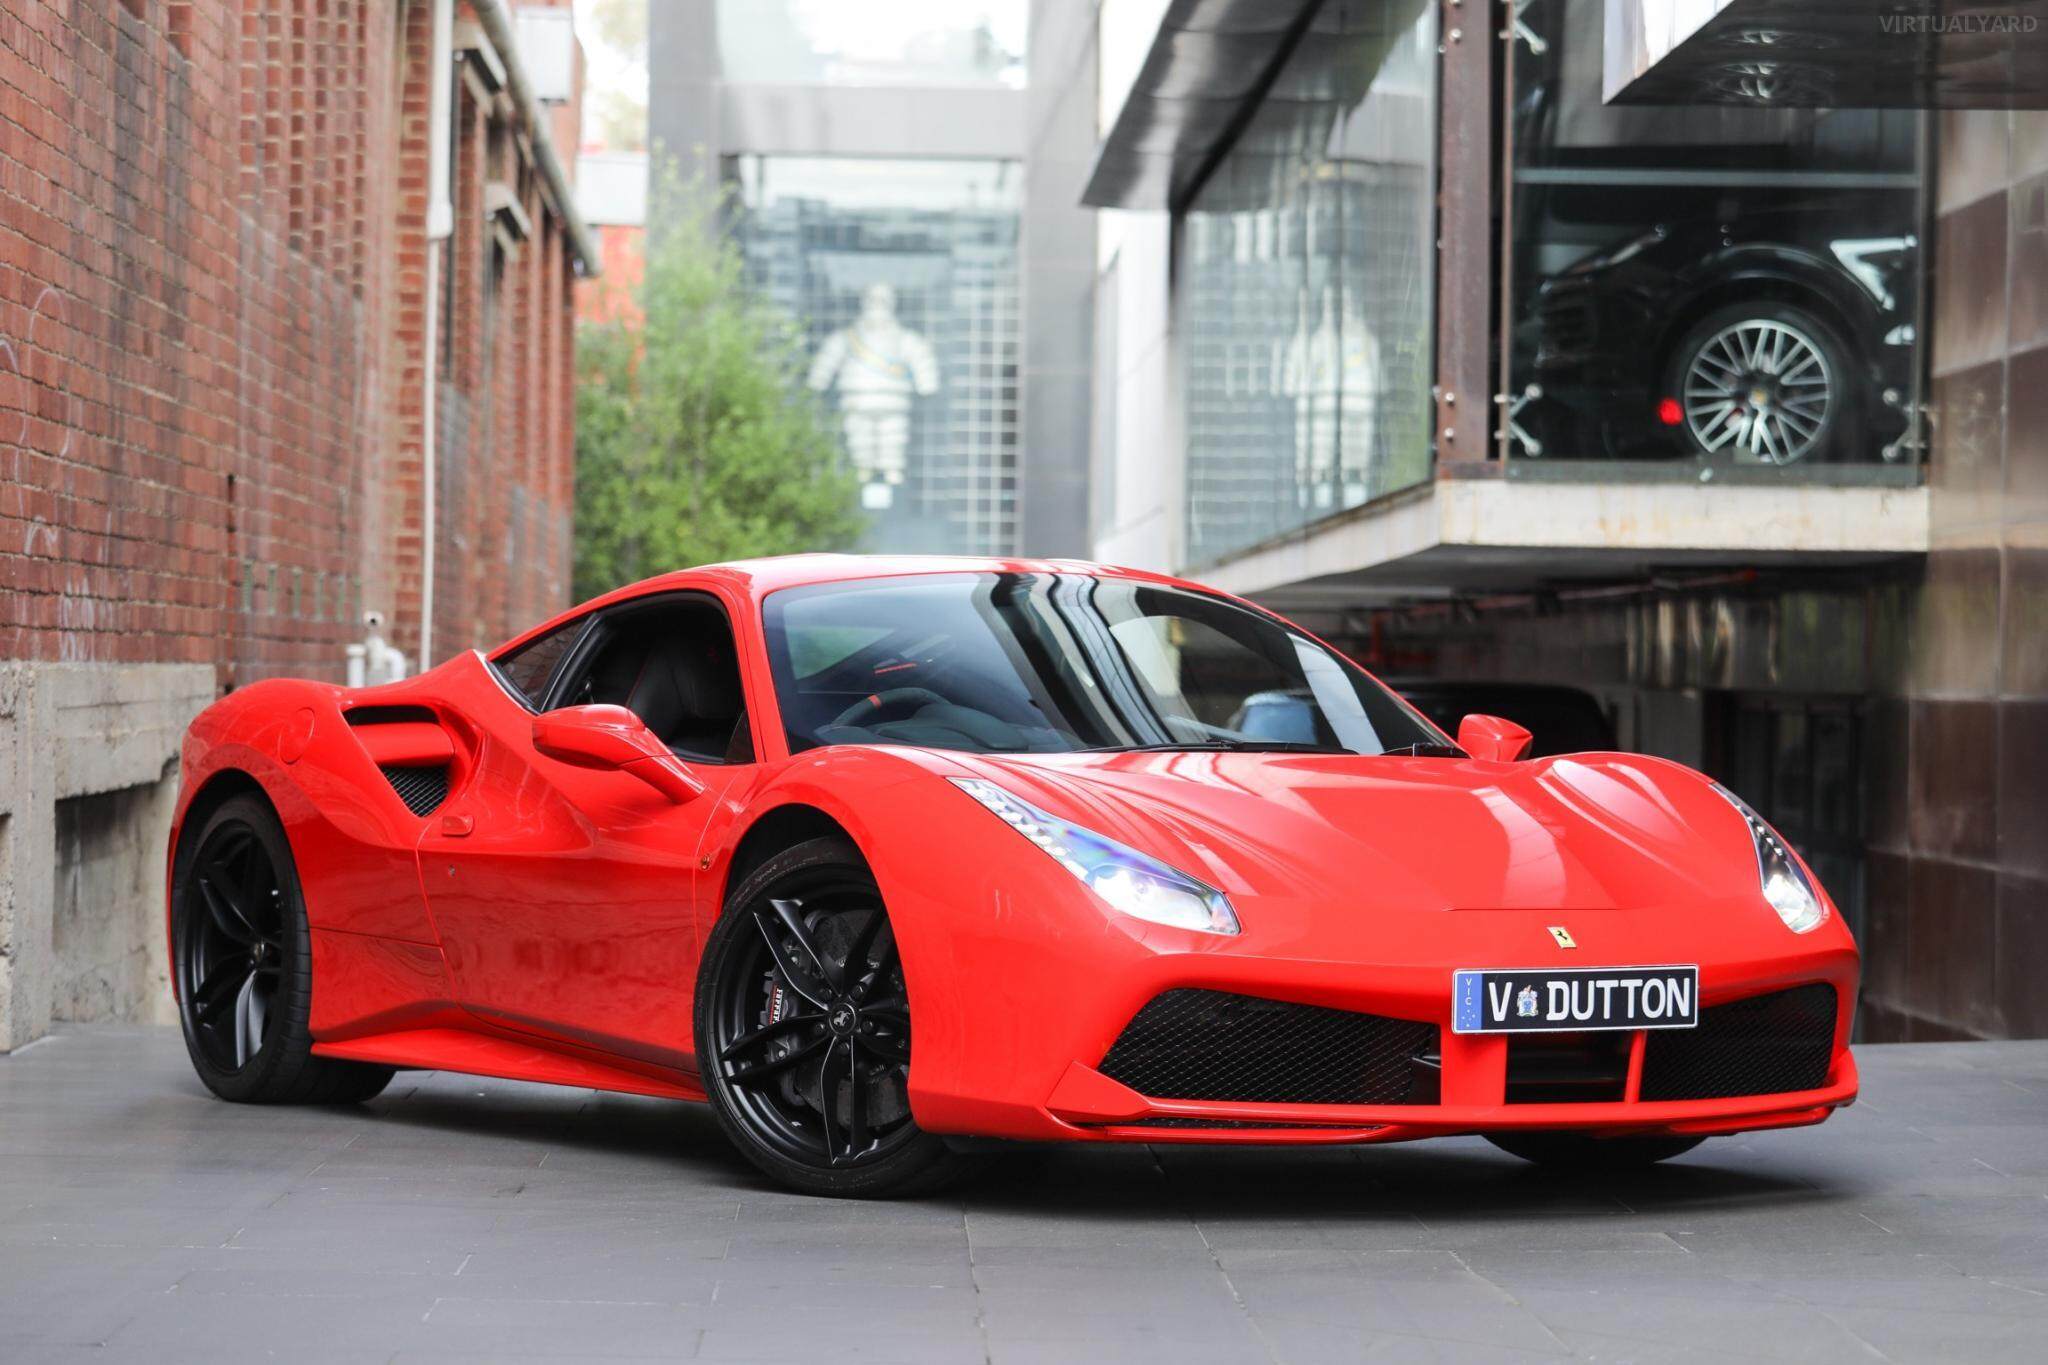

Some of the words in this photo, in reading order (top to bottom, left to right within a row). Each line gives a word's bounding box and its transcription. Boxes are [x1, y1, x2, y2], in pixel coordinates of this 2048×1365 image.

[1465, 977, 1473, 1006] VIC
[1488, 981, 1513, 1022] V
[1546, 977, 1691, 1021] DUTTON
